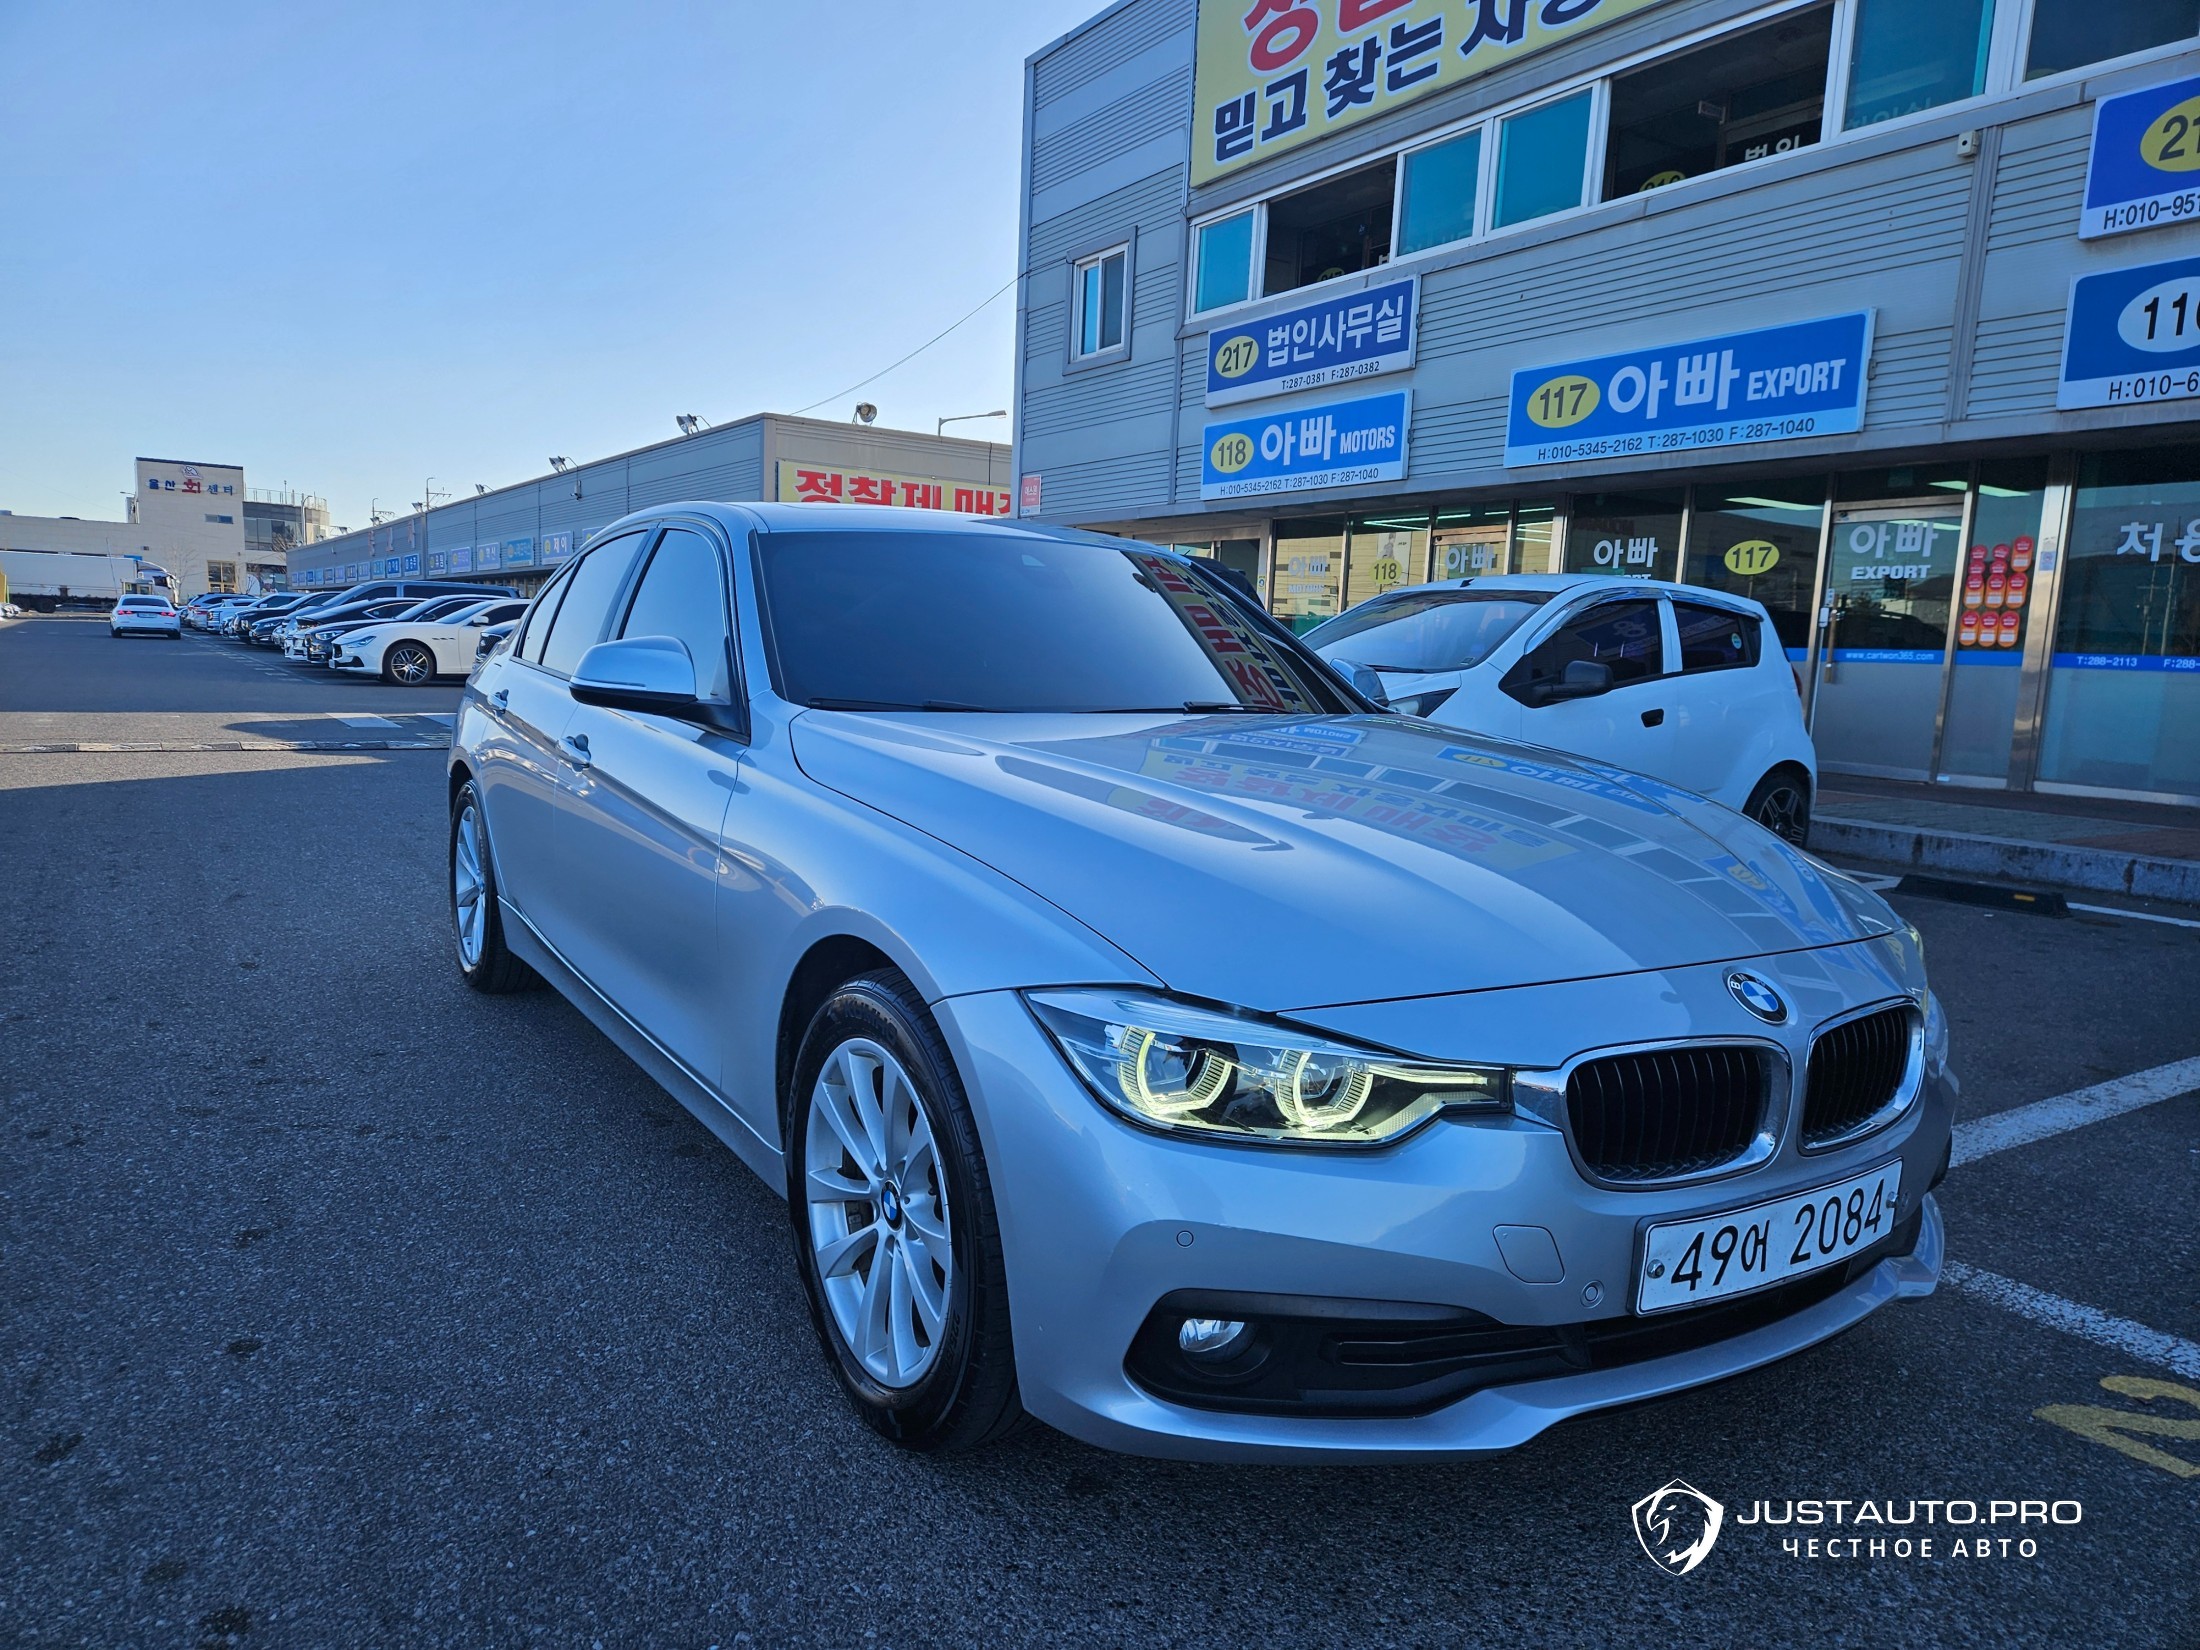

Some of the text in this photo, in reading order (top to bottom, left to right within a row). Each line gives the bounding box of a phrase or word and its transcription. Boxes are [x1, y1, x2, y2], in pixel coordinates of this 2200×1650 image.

[1215, 69, 1308, 162] 믿고
[1324, 18, 1443, 119] 찾는
[1221, 295, 1404, 373] 217 법인사무실
[1282, 361, 1380, 390] T:287-0381 F:287-0382
[1539, 349, 1846, 420] 117 아빠 EXPORT
[1218, 415, 1396, 467] 118 아빠 MOTORS
[1538, 418, 1815, 460] H:010-5345-2162 T:287-1030 F:287-1040
[182, 479, 201, 494] 회
[207, 484, 233, 496] 센터
[1220, 468, 1379, 495] H:010-5345-2162 T:287-1030 F:287-1040
[1593, 537, 1658, 569] 아빠
[1850, 521, 1939, 559] 아빠
[1288, 555, 1328, 579] 아빠
[1374, 562, 1397, 580] 118
[1445, 544, 1496, 573] 아빠
[1732, 546, 1772, 569] 117
[1851, 564, 1931, 580] EXPORT
[2076, 656, 2138, 667] T:288-2113
[1671, 1178, 1885, 1291] 49어 2084
